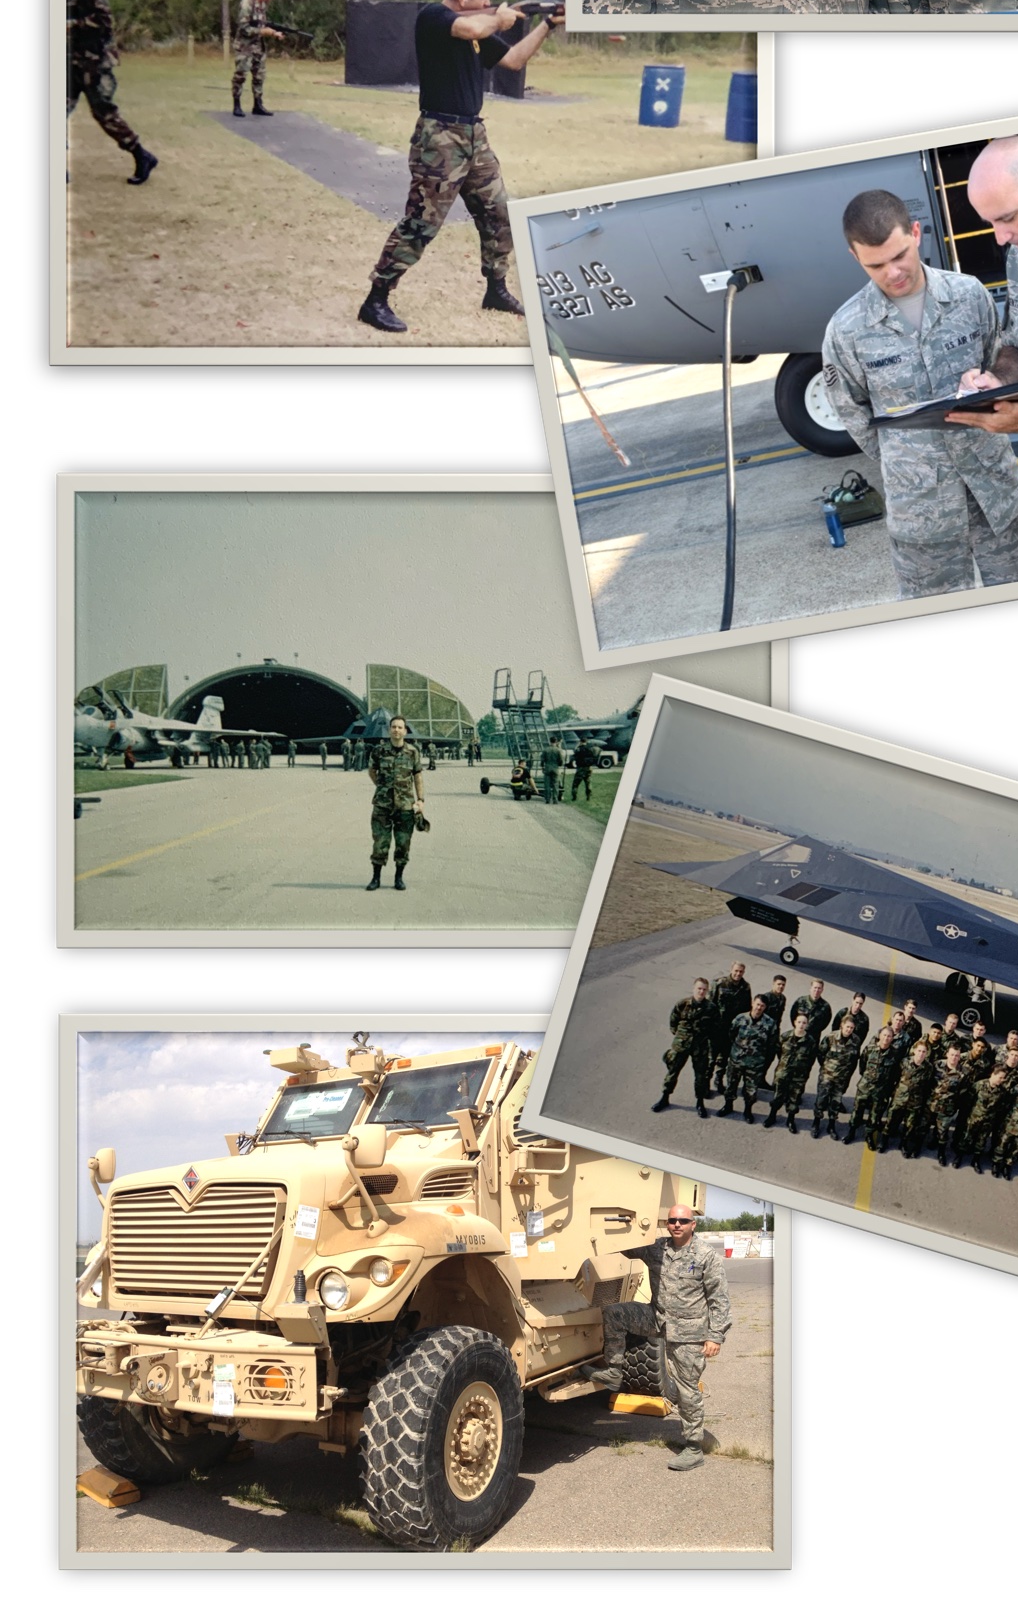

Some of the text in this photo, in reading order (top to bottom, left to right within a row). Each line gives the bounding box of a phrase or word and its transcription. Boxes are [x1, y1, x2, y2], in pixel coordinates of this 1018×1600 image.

[579, 261, 615, 289] AG
[549, 286, 636, 320] 327 AS
[866, 355, 902, 369] HAMMONDS
[188, 1394, 201, 1404] TOW
